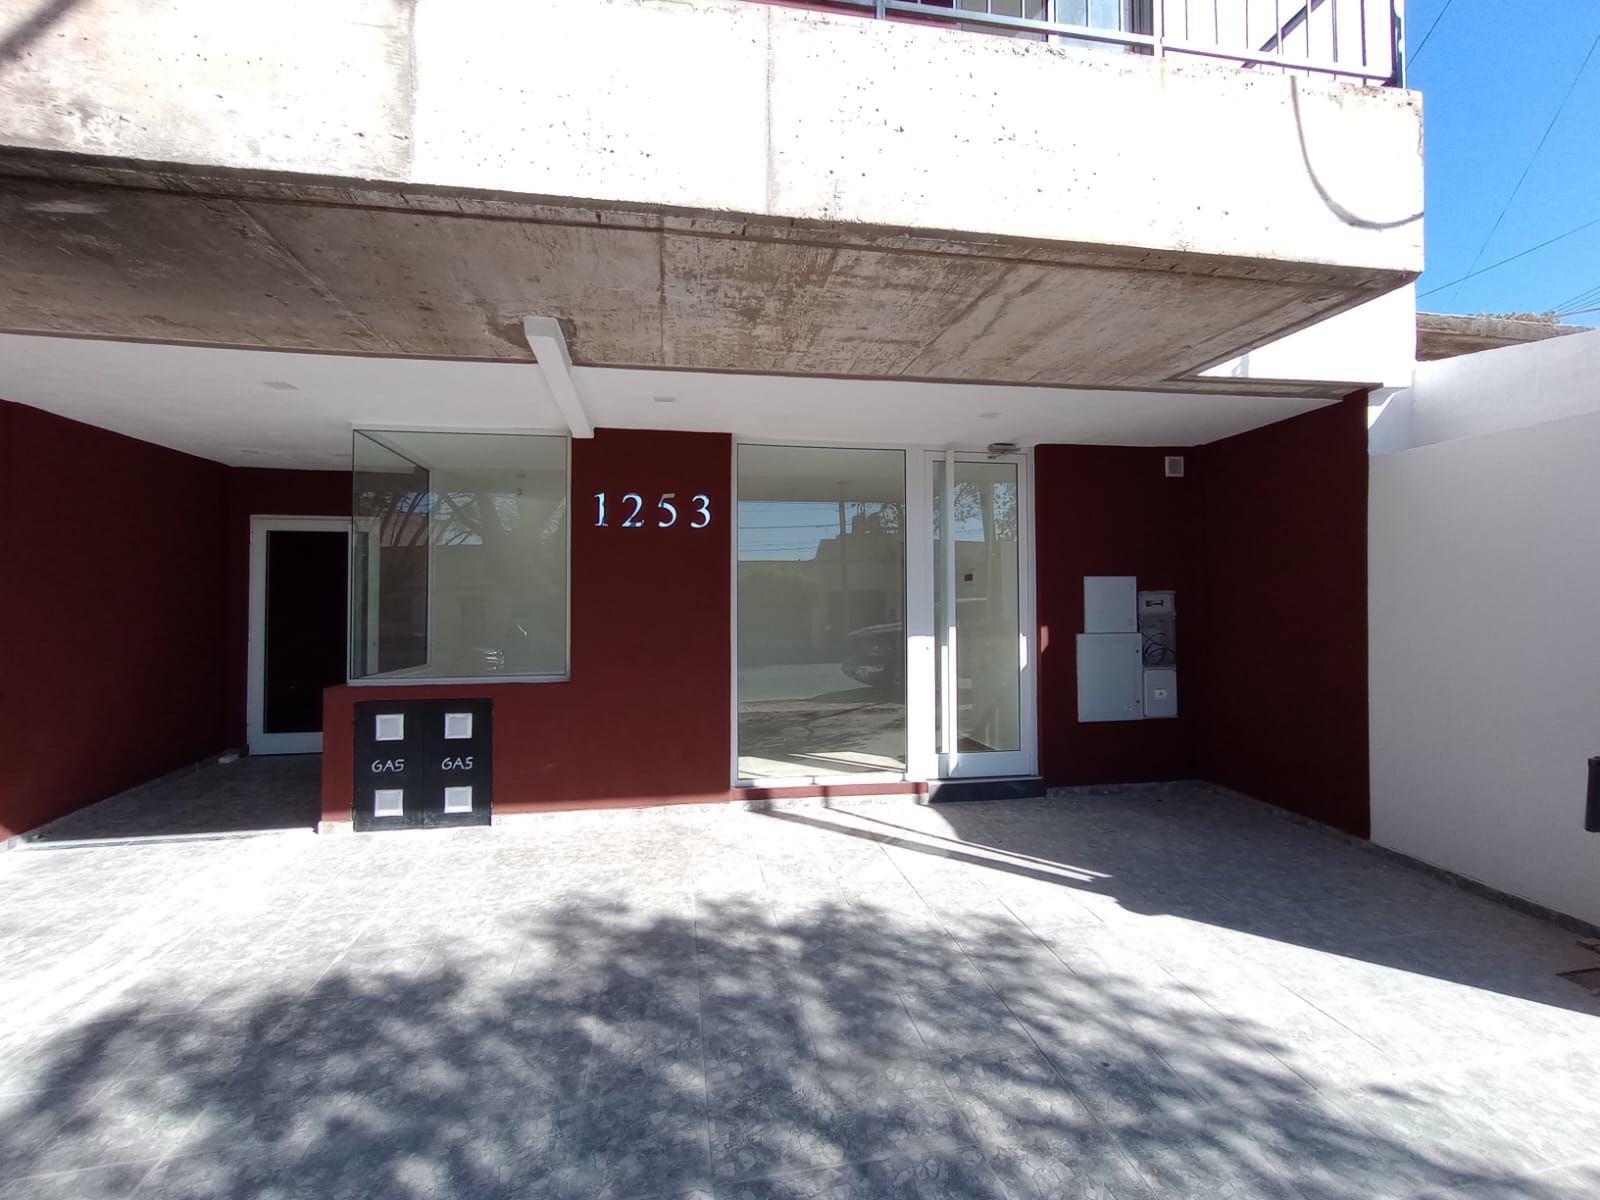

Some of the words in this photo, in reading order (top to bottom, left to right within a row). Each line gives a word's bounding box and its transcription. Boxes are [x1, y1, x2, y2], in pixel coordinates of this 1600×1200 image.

[594, 491, 712, 529] 1253
[371, 758, 405, 773] GAS
[441, 756, 474, 771] GAS
